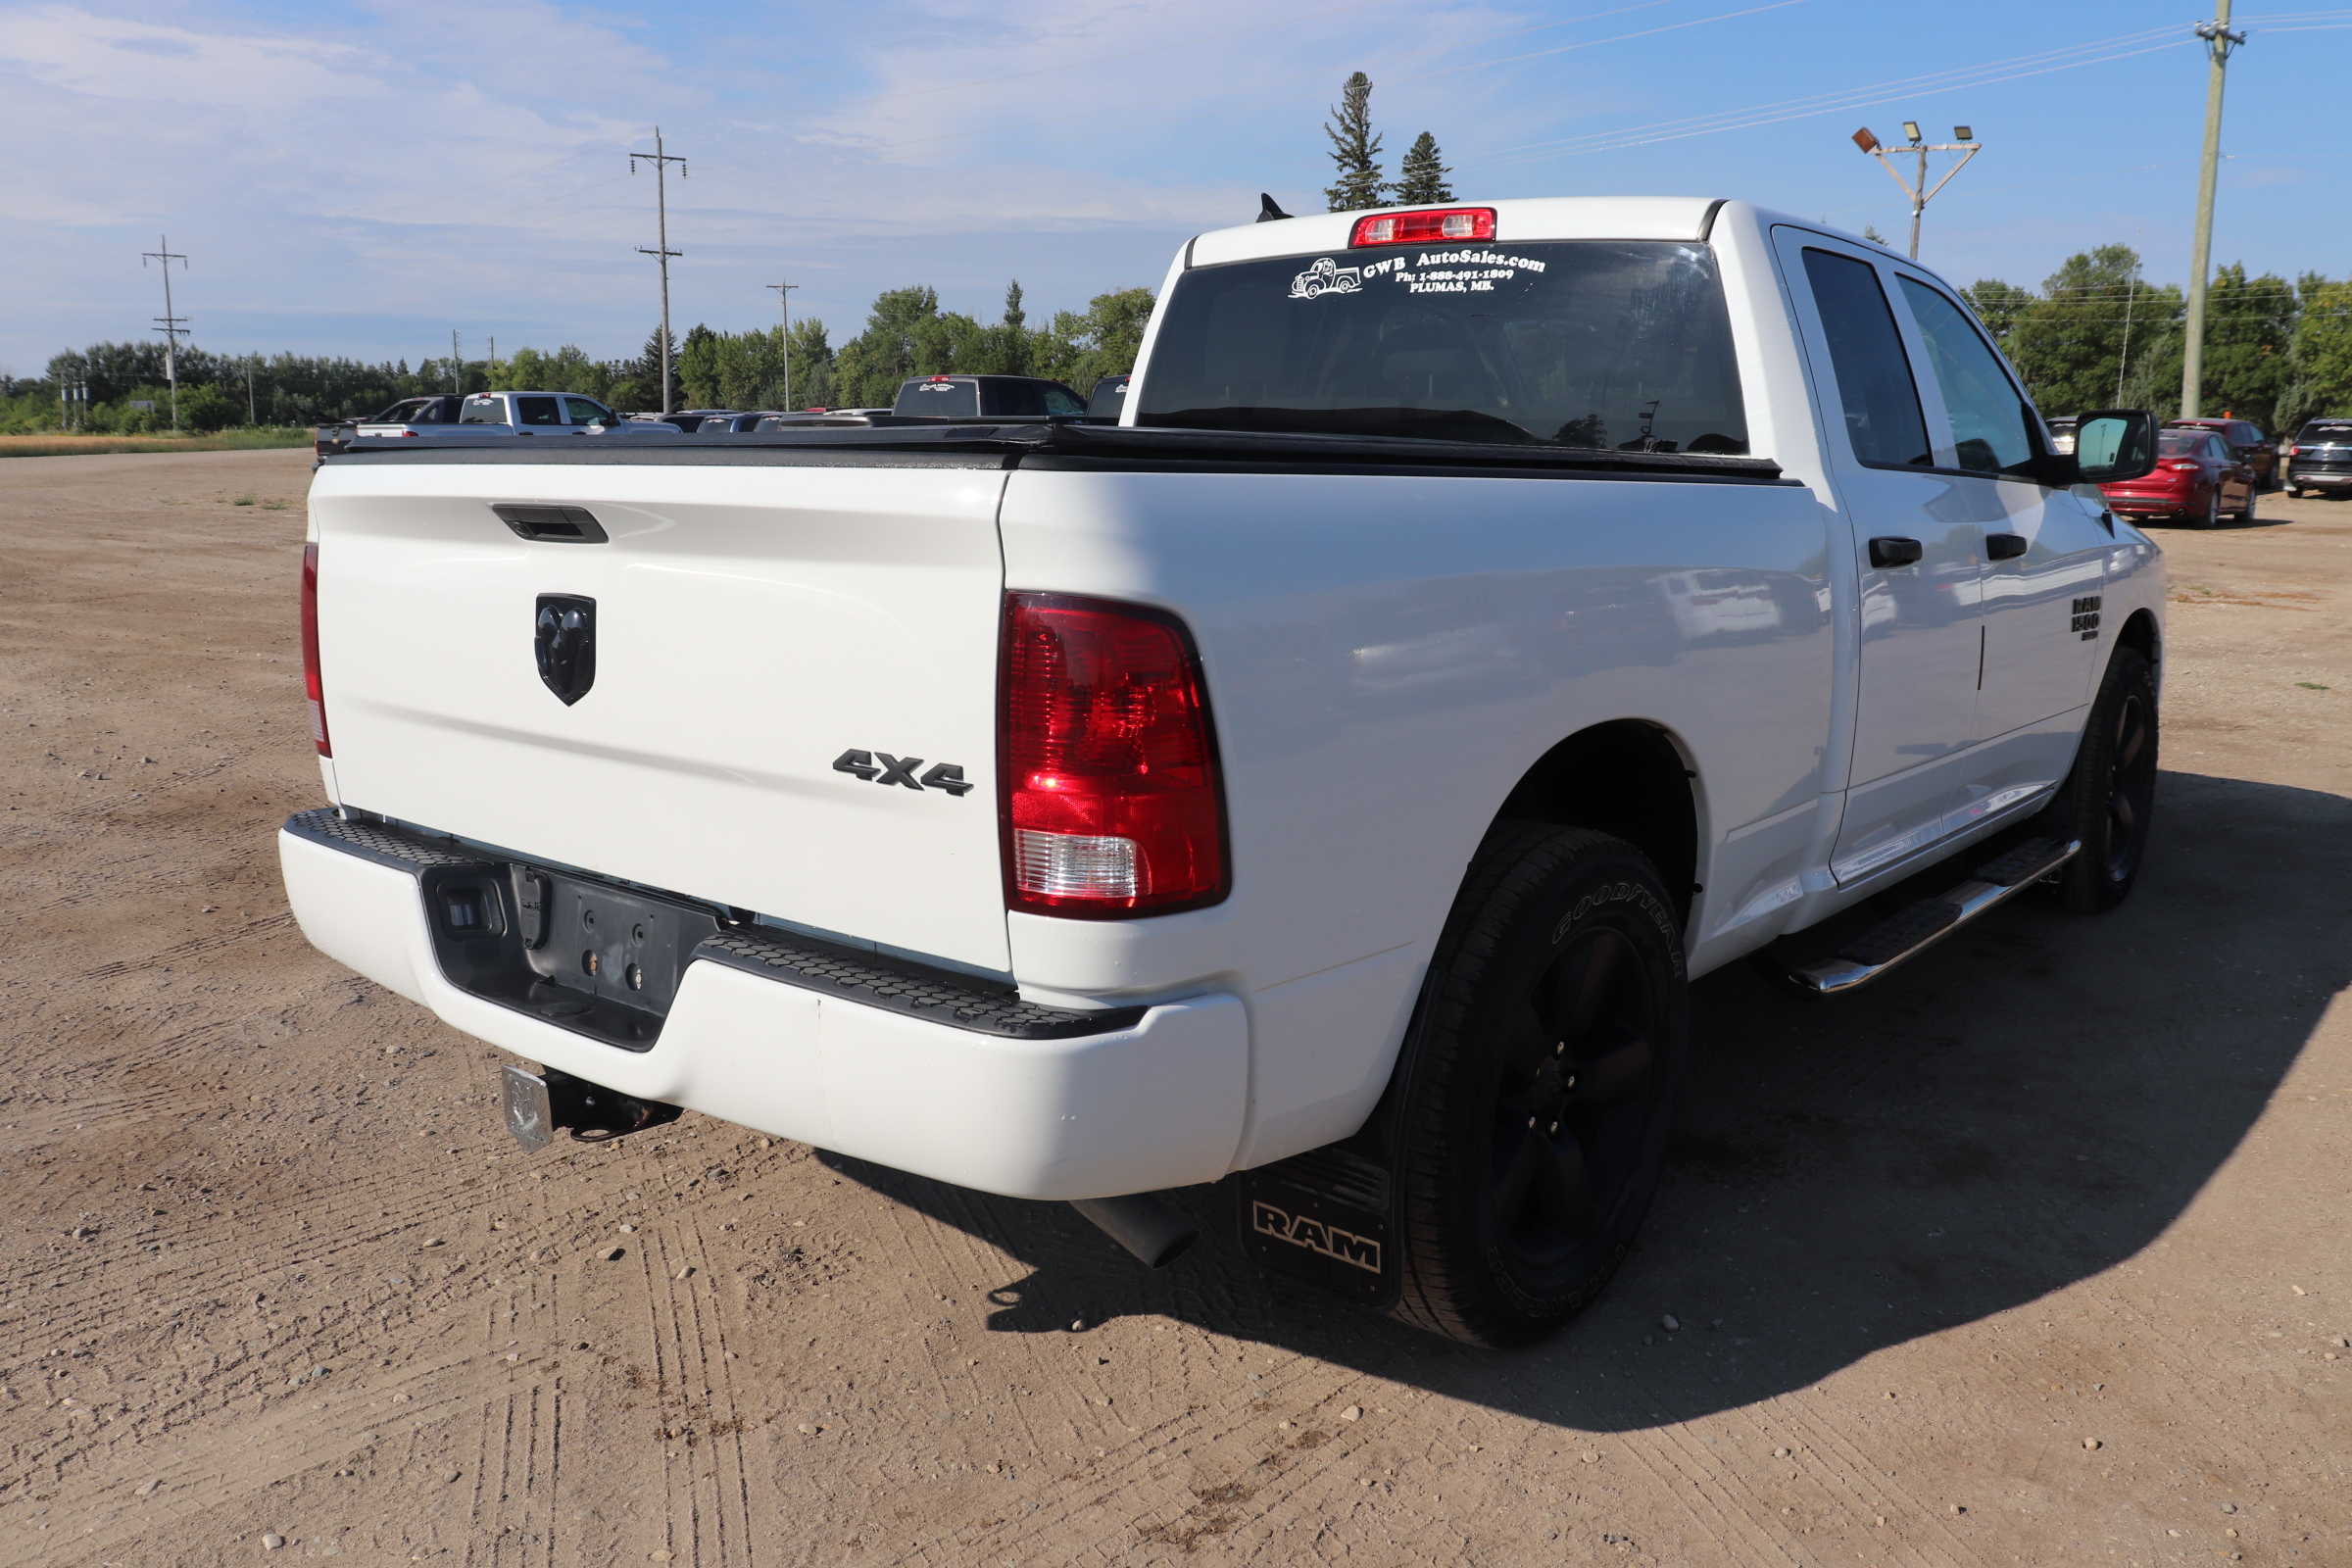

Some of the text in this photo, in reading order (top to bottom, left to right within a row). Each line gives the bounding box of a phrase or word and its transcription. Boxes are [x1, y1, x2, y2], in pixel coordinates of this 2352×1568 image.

[1363, 250, 1545, 278] GWB AutoSales.com
[1395, 270, 1514, 282] Ph: 1-888-491-1809
[1409, 280, 1494, 293] PLUMAS, MB.
[1552, 882, 1684, 978] GOODYEAR
[1252, 1200, 1381, 1274] RAM
[1487, 1243, 1626, 1317] WRANGLER
